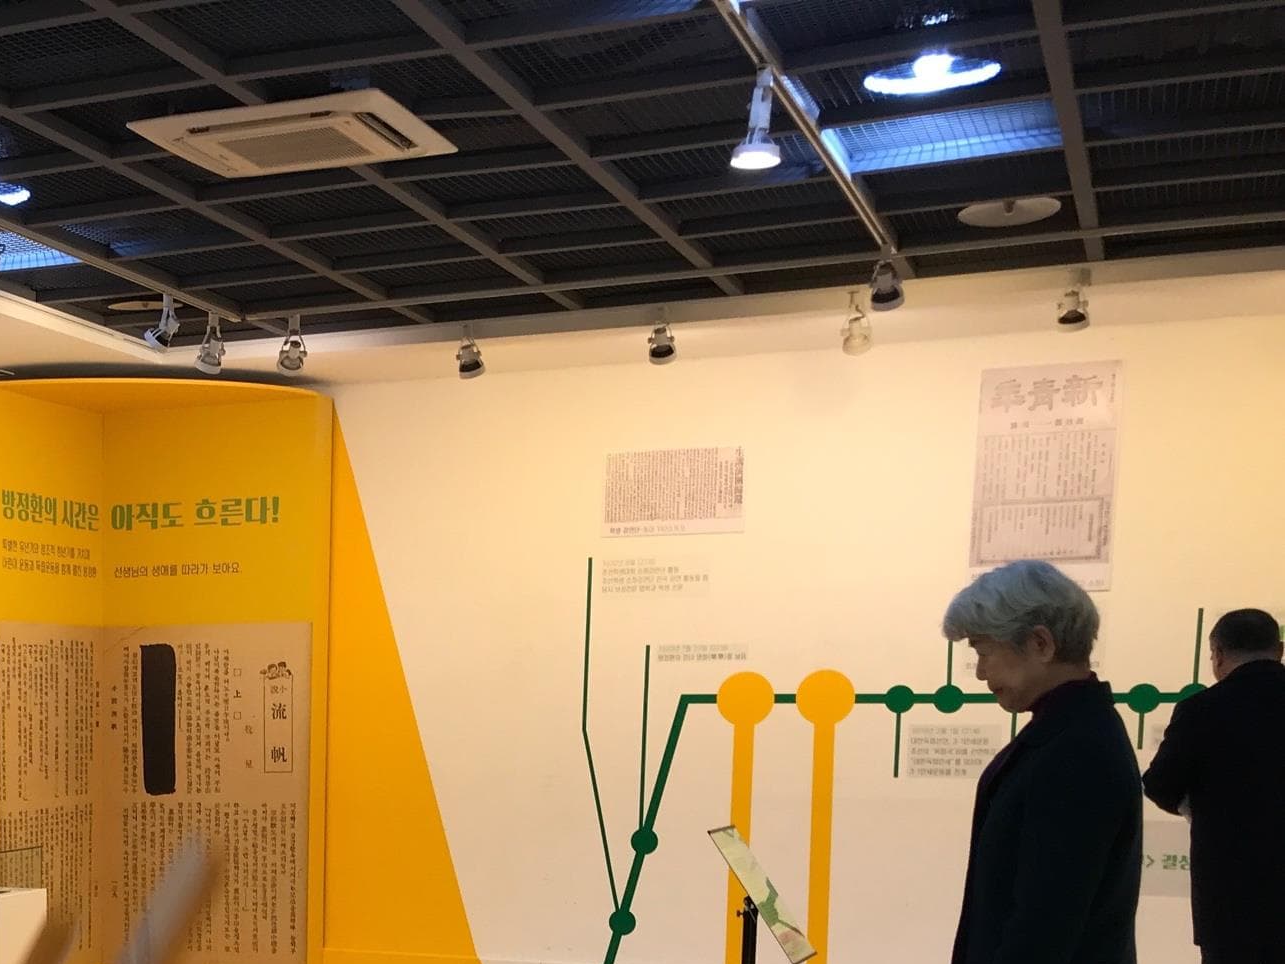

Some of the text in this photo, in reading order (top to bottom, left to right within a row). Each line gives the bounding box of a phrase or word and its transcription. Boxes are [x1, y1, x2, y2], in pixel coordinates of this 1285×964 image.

[1, 489, 280, 531] 방정환의 시간은 아직도 흐른다!
[114, 565, 148, 579] 선생님의
